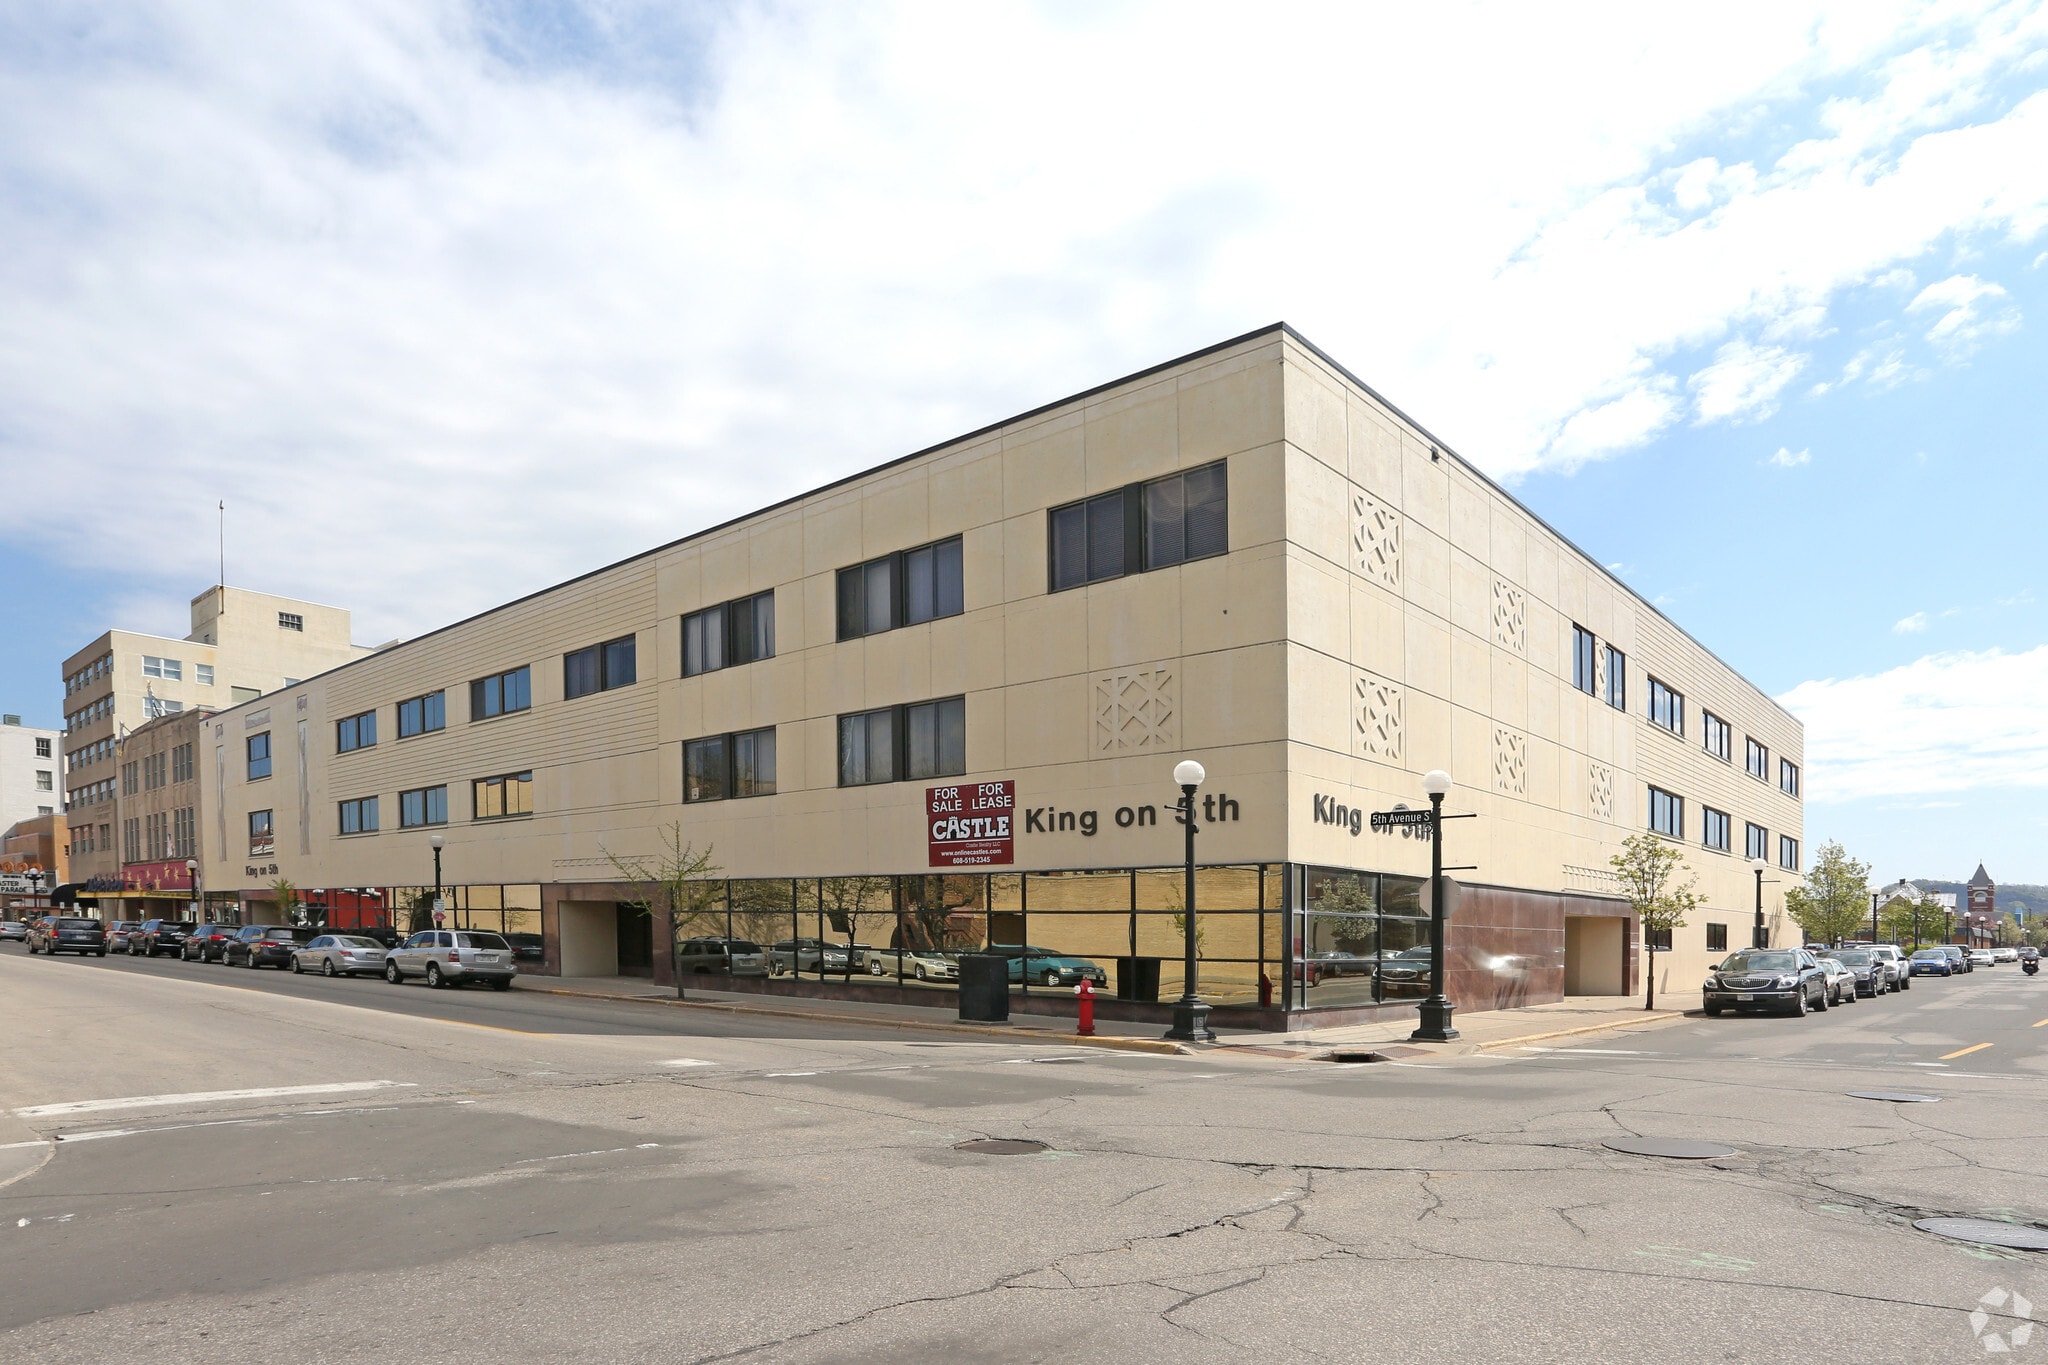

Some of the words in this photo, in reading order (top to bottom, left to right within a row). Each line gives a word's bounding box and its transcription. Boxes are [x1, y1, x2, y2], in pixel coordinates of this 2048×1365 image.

[934, 788, 958, 800] FOR
[978, 783, 1004, 796] FOR
[932, 800, 963, 813] SALE
[972, 795, 1012, 810] LEASE
[1025, 806, 1098, 837] King
[1115, 804, 1156, 828] on
[1314, 793, 1361, 836] King
[1372, 814, 1387, 824] 5th
[1389, 813, 1422, 824] Avenue
[1423, 811, 1430, 821] S
[932, 816, 1009, 840] CASTLE
[246, 865, 257, 878] King
